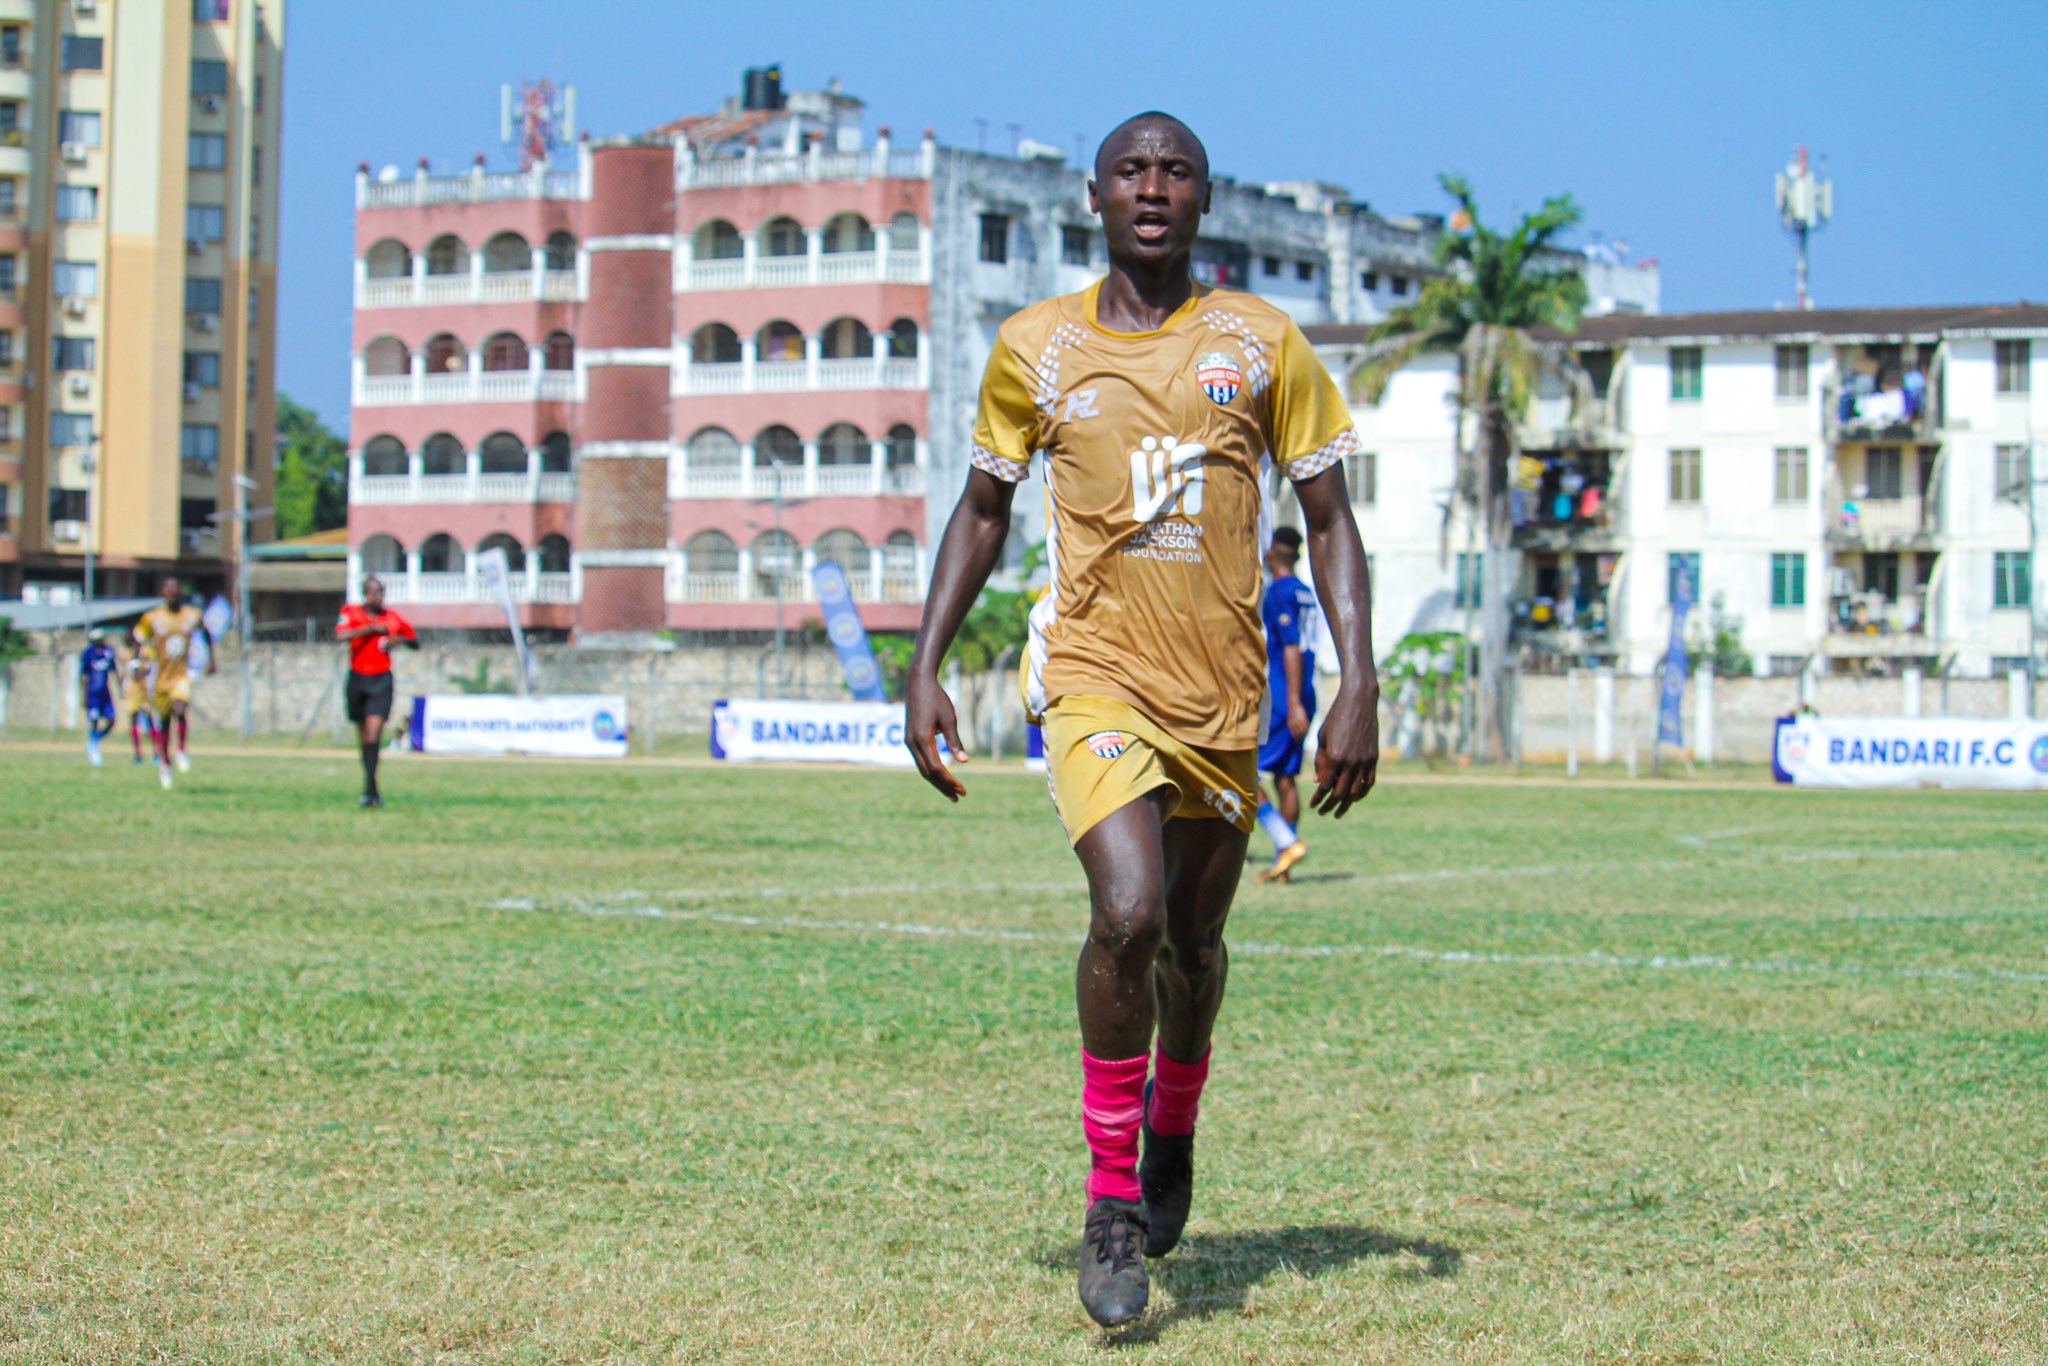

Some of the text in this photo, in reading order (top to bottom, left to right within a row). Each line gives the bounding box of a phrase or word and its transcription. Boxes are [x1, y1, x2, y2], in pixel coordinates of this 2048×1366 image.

[1226, 370, 1241, 383] CITY
[1138, 522, 1204, 537] NATHAN
[1130, 534, 1197, 549] JACKSON
[1123, 547, 1203, 563] FOUNDATION
[472, 718, 510, 732] PORTS
[515, 718, 586, 733] AUTHORITY
[752, 719, 902, 746] BANDARI F.C
[1830, 738, 2015, 765] BANDARI F.C
